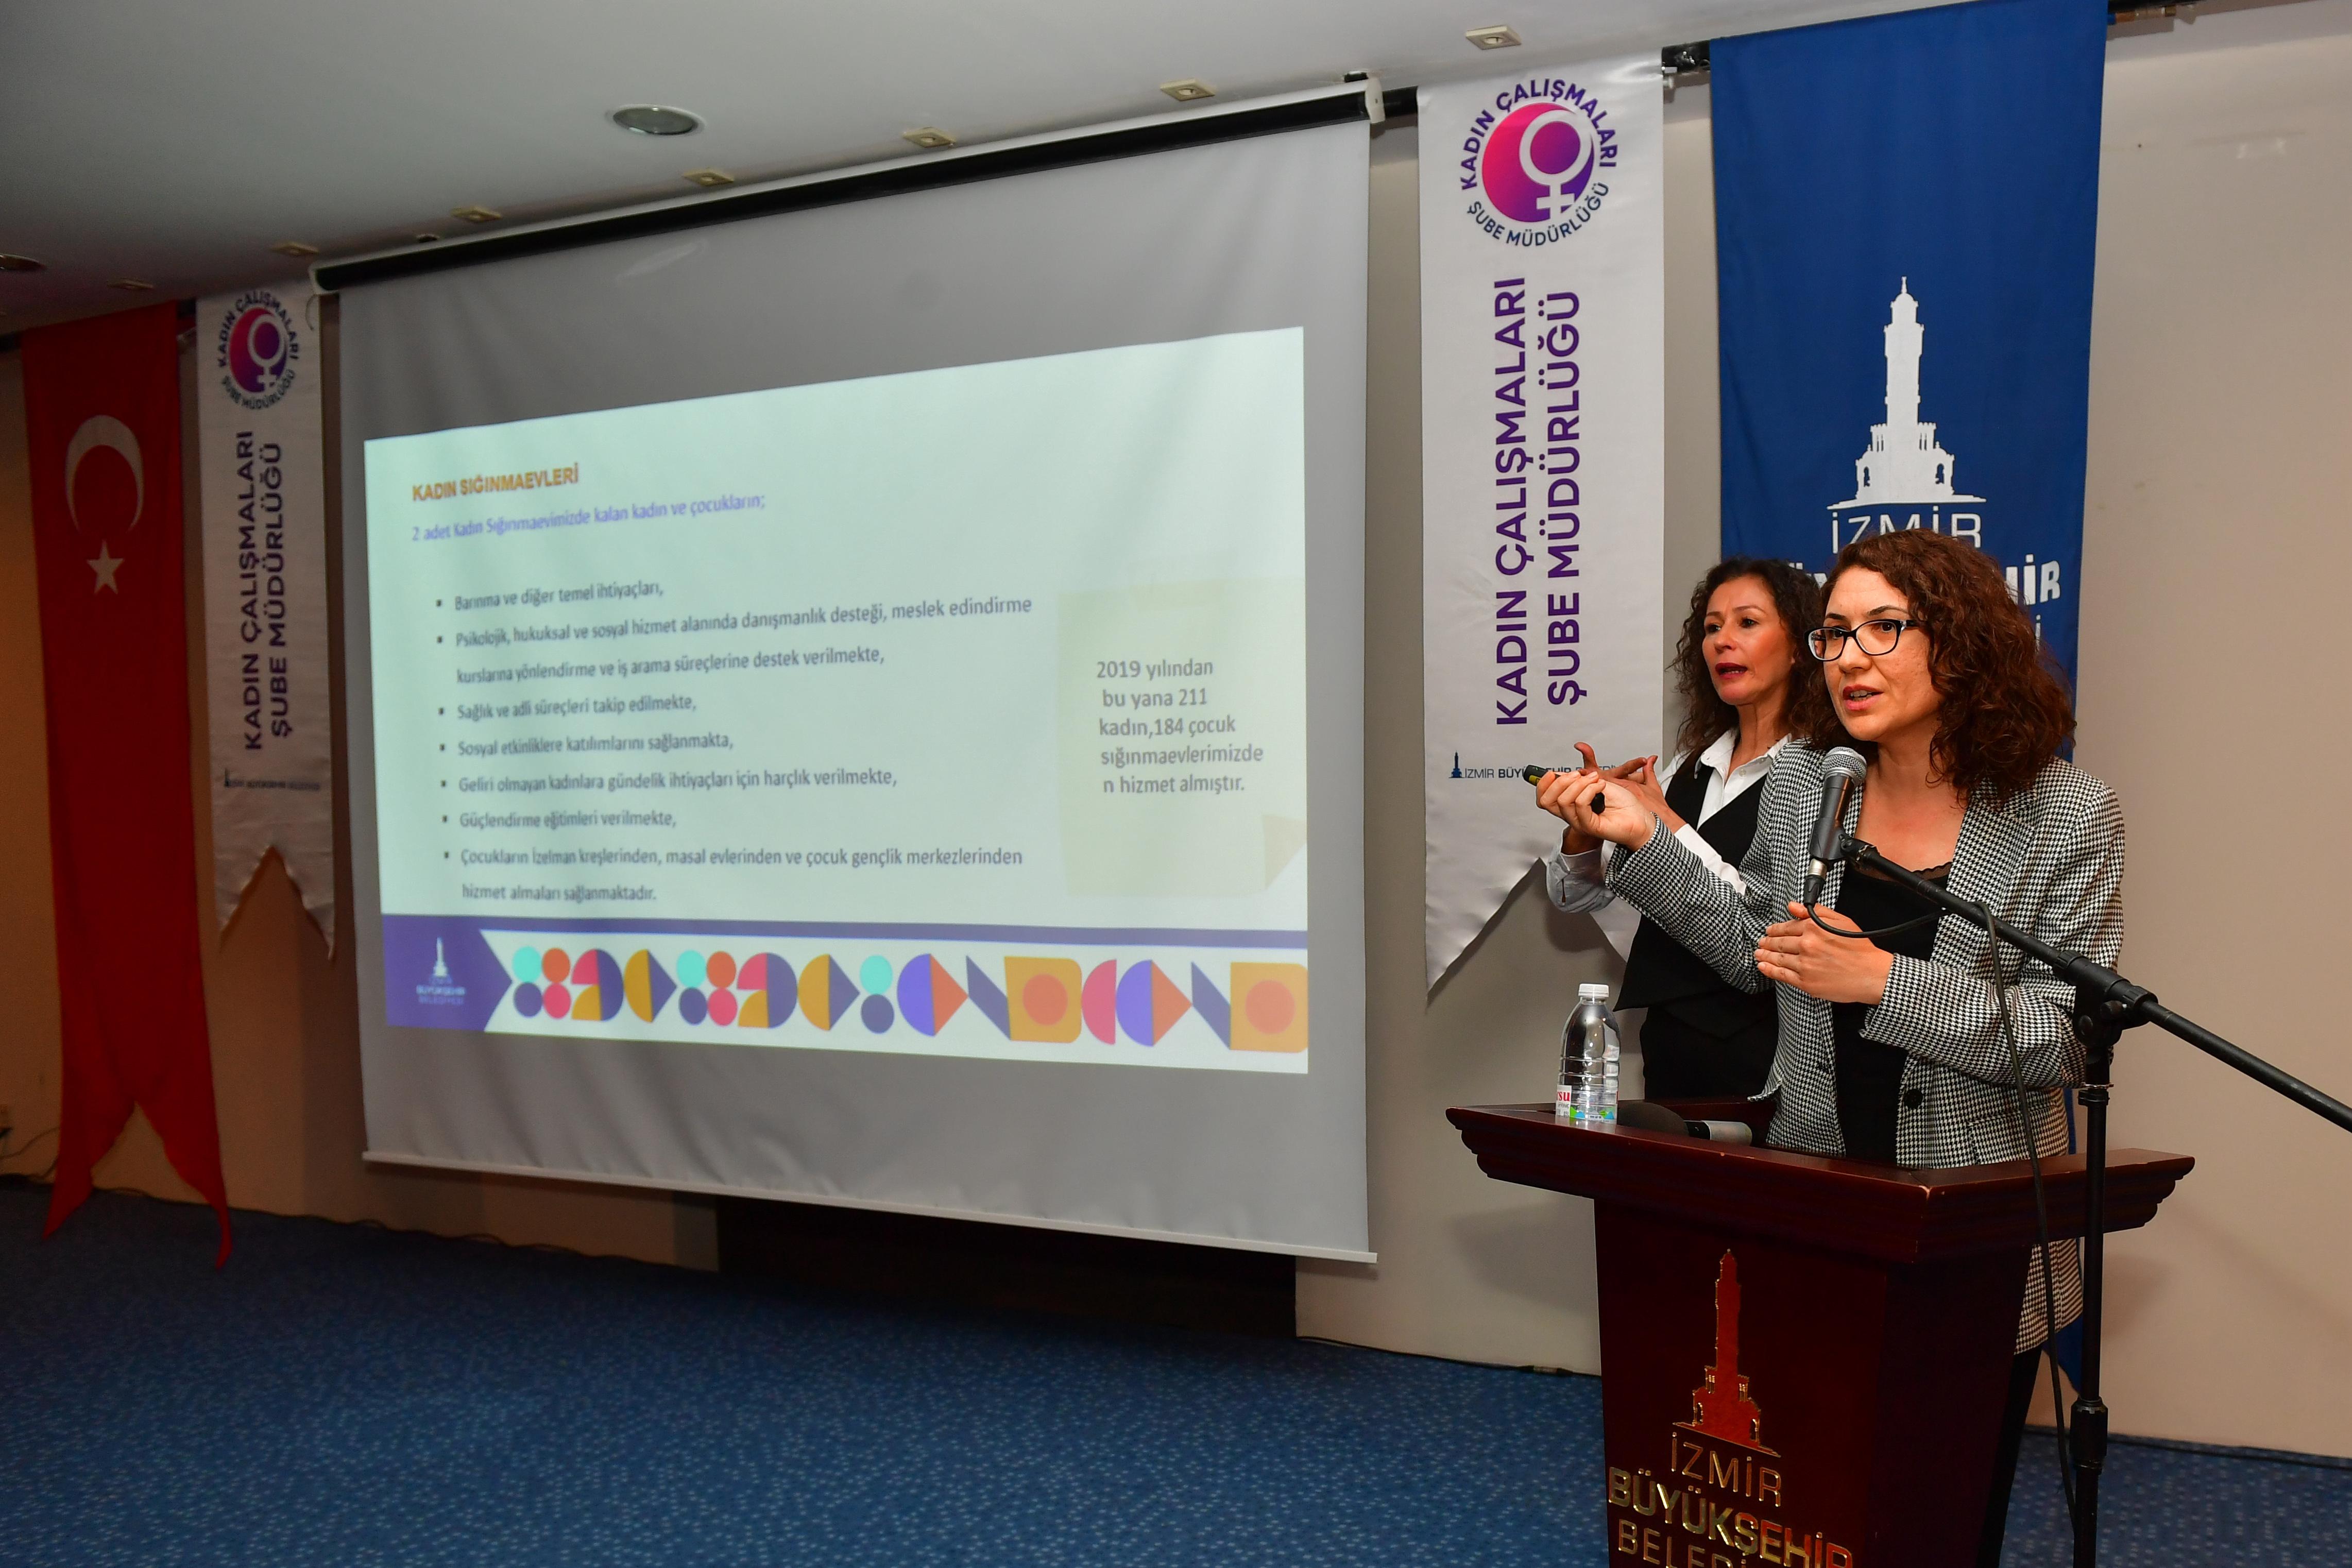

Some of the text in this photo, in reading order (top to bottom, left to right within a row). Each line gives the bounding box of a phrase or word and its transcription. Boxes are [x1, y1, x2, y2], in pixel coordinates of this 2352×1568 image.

[1460, 78, 1618, 191] KADIN ÇALIŞMALARI
[1467, 181, 1609, 247] ŞUBE MÜDÜRLÜĞÜ
[413, 462, 578, 501] KADIN SIĞINMAEVLERİ
[1494, 277, 1535, 725] KADIN ÇALIŞMALARI
[1538, 291, 1588, 705] ŞUBE MÜDÜRLÜĞÜ
[413, 526, 419, 541] 2
[424, 522, 450, 539] adet
[594, 505, 627, 522] kalan
[632, 502, 667, 518] kadın
[672, 503, 686, 514] ve
[236, 431, 261, 750] KADIN ÇALIŞMALARI
[259, 442, 294, 738] ŞUBE MÜDÜRLÜĞÜ
[455, 581, 663, 610] Barınma ve diğer temel ihtiyaçları,
[514, 624, 570, 641] hukuksal
[574, 626, 588, 637] ve
[592, 620, 627, 641] sosyal
[632, 619, 676, 634] hizmet
[680, 613, 738, 632] alanında
[742, 608, 825, 630] danışmanlık
[830, 604, 887, 624] desteği,
[892, 600, 944, 618] meslek
[949, 596, 1032, 615] edindirme
[516, 661, 595, 682] yönlendirme
[600, 664, 614, 675] ve
[618, 659, 627, 678] iş
[632, 660, 670, 673] arama
[674, 653, 749, 672] süreçlerine
[754, 650, 799, 667] destek
[803, 646, 884, 664] verilmekte,
[1097, 658, 1213, 680] 2019 yılından
[457, 703, 493, 721] Sağlık
[496, 706, 509, 717] ve
[535, 697, 589, 718] süreçleri
[593, 697, 625, 714] takip
[629, 695, 696, 712] edilmekte,
[1103, 688, 1207, 710] bu yana 211
[1189, 714, 1236, 738] çocuk
[458, 740, 497, 758] Sosyal
[501, 737, 563, 754] etkinliklere
[648, 732, 733, 753] sağlanmakta,
[1101, 743, 1264, 768] sığınmaevlerimizde
[459, 768, 897, 793] Geliri olmayan kadınlara gündelik ihtiyaçları için harçlık verilmekte,
[1103, 774, 1245, 794] n hizmet almıştır.
[1465, 768, 1494, 778] İZMİR
[459, 812, 540, 829] Güçlendirme
[601, 810, 676, 827] verilmekte,
[461, 848, 529, 865] Çocukların
[667, 848, 705, 863] masal
[710, 849, 781, 864] evlerinden
[785, 851, 802, 864] ve
[806, 849, 847, 867] çocuk
[851, 848, 901, 867] gençlik
[907, 847, 1022, 864] merkezlerinden
[462, 884, 506, 899] hizmet
[510, 884, 560, 900] almaları
[1671, 1432, 1781, 1507] İZMİR
